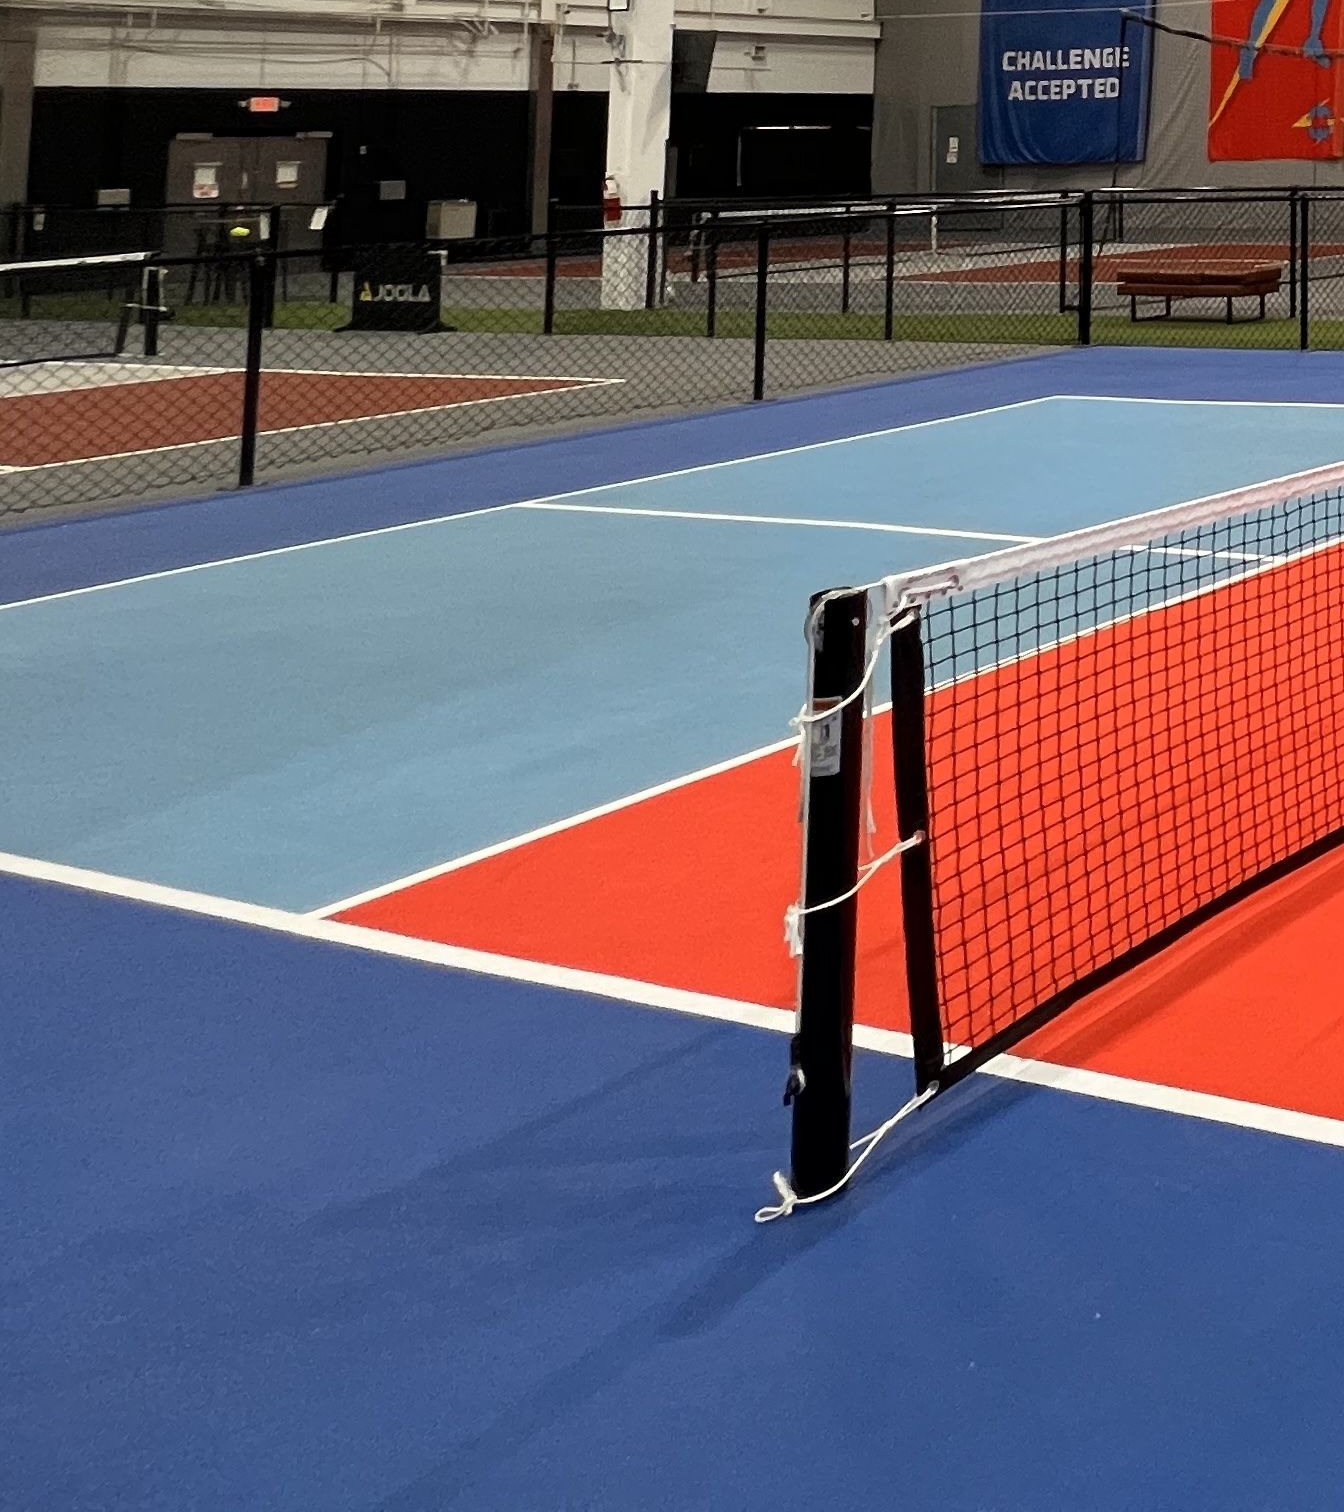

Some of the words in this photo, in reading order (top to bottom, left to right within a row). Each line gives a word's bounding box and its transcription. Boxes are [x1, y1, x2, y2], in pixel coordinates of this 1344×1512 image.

[1002, 45, 1131, 71] CHALLENGE
[1007, 76, 1121, 101] ACCEPTED
[373, 283, 432, 303] JOOLA
